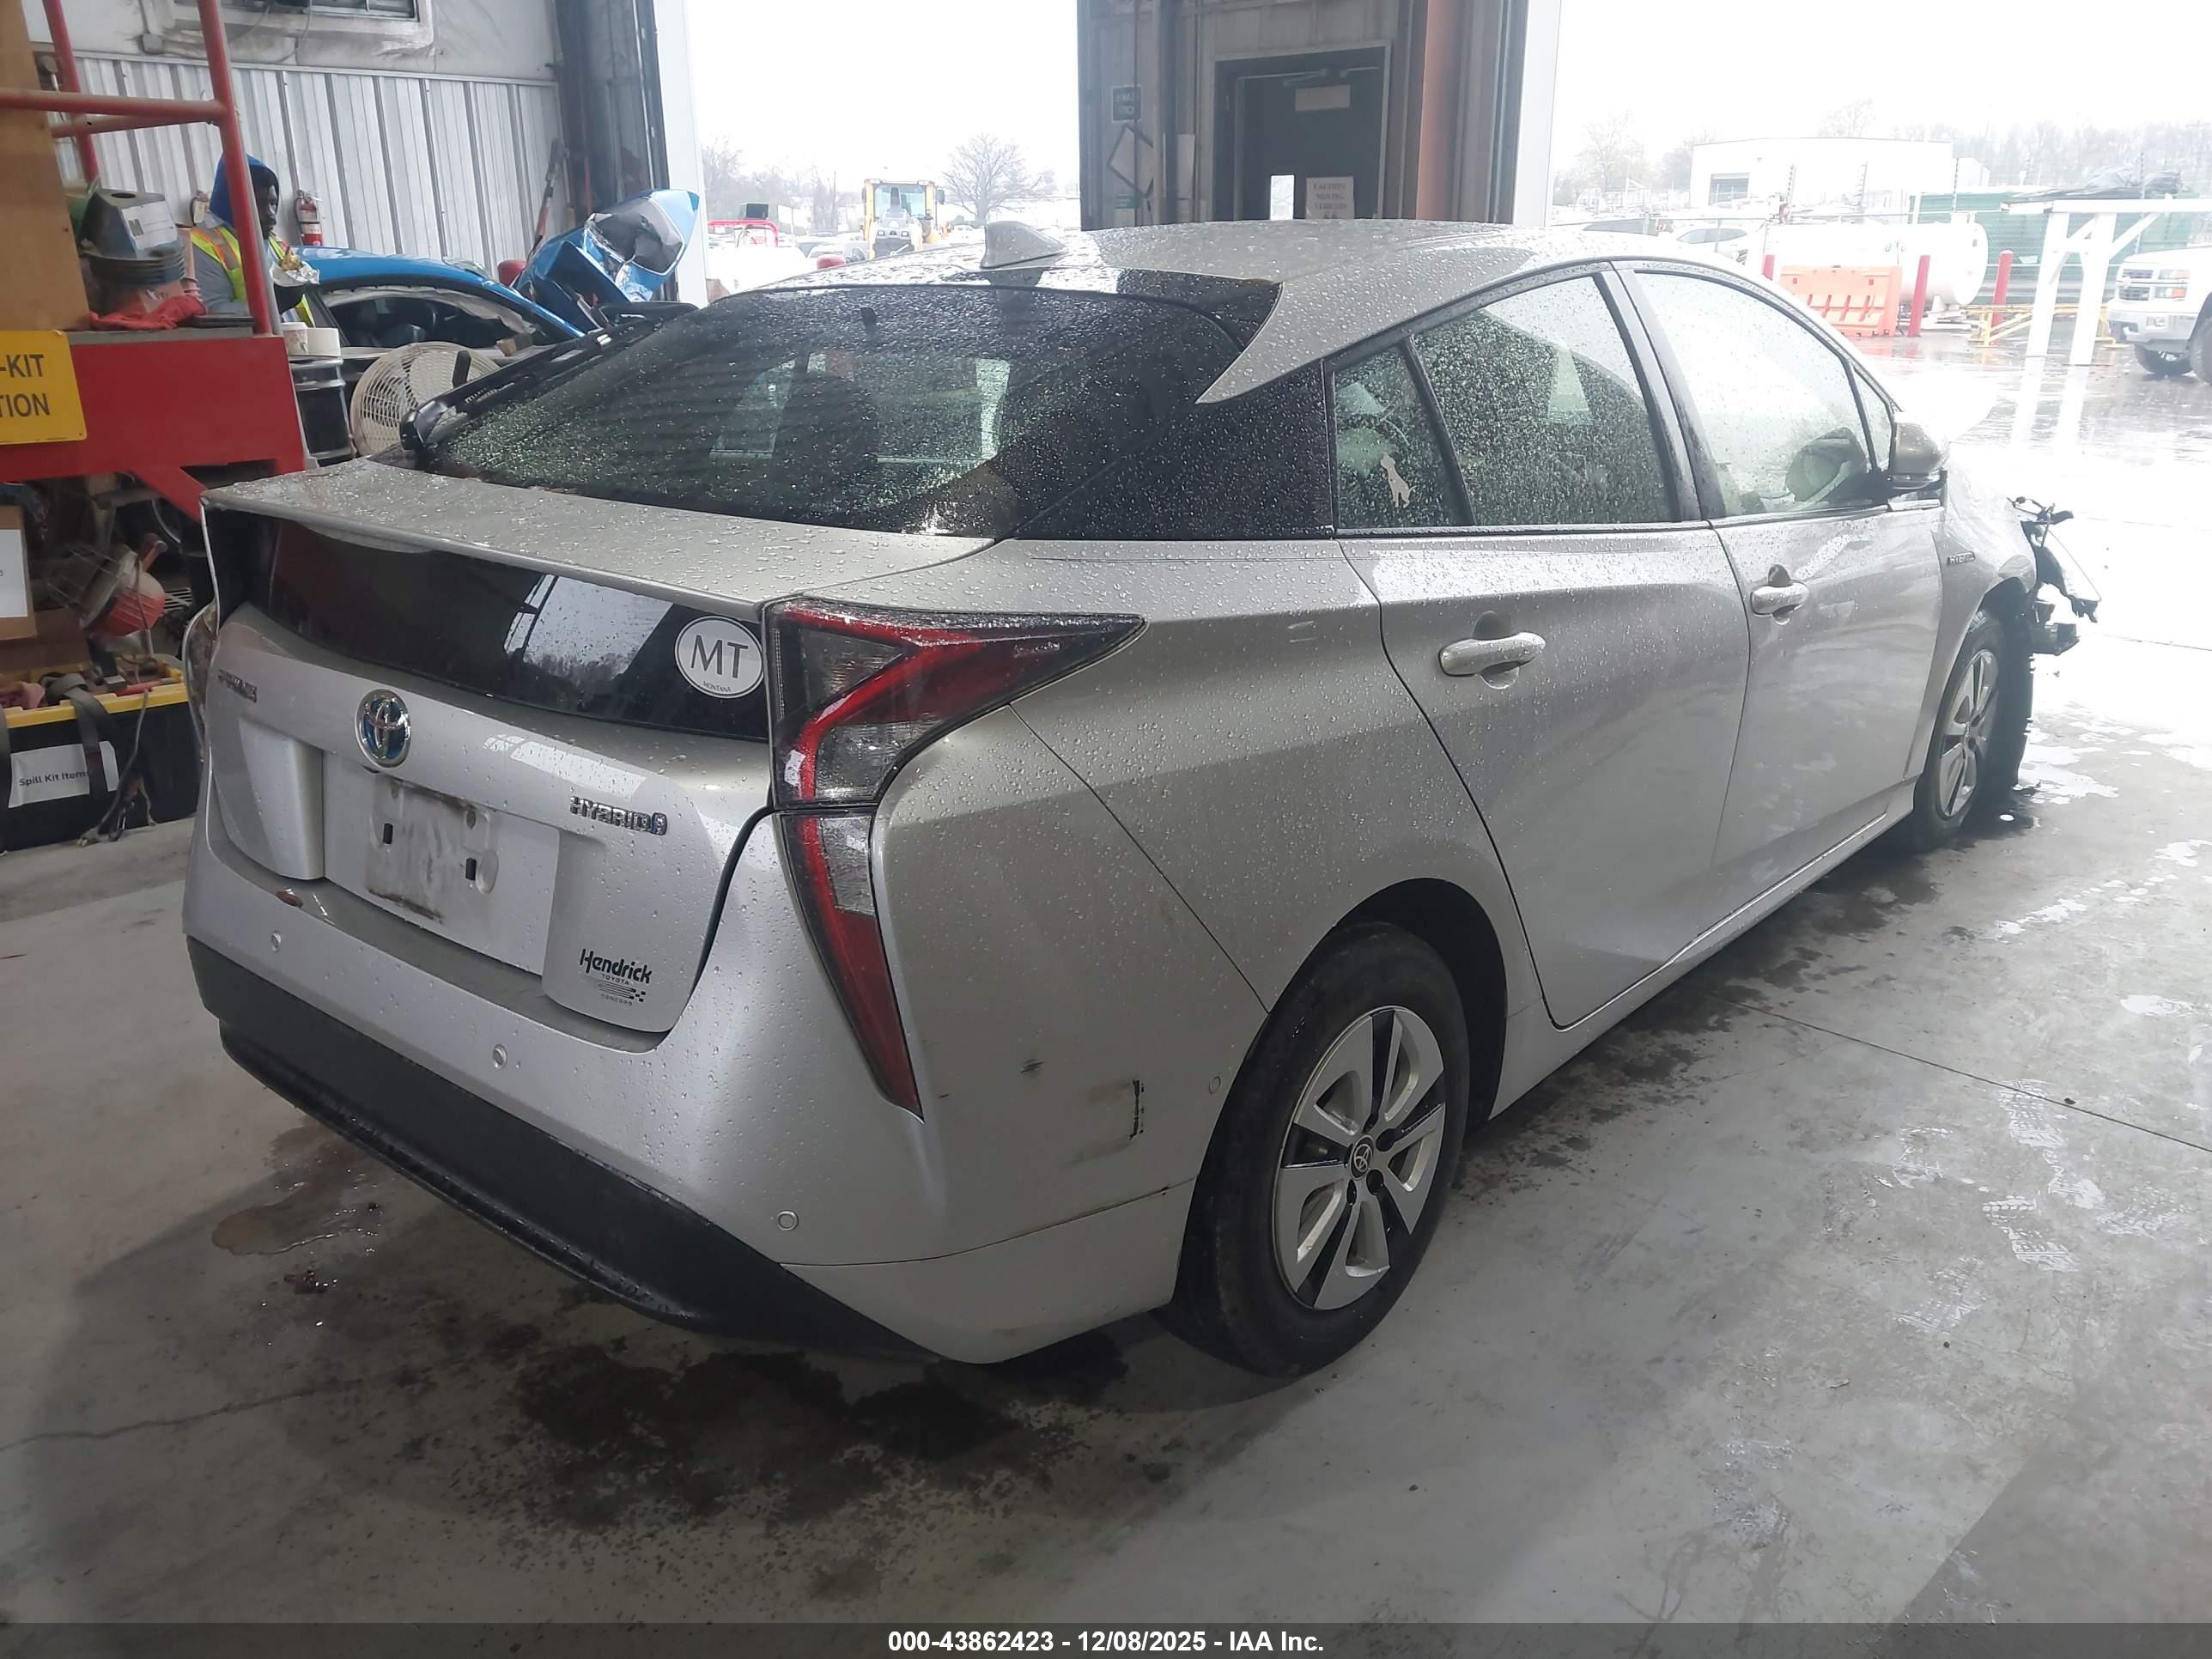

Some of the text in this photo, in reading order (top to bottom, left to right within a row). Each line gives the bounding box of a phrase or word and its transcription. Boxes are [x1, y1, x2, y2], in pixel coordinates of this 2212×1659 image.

[690, 635, 749, 679] MT
[703, 680, 732, 693] MONTANA
[19, 776, 42, 787] Spill
[45, 774, 59, 782] Kit
[569, 796, 651, 832] HYBRID
[580, 948, 653, 984] Hendrick
[602, 974, 629, 985] TOYOTA
